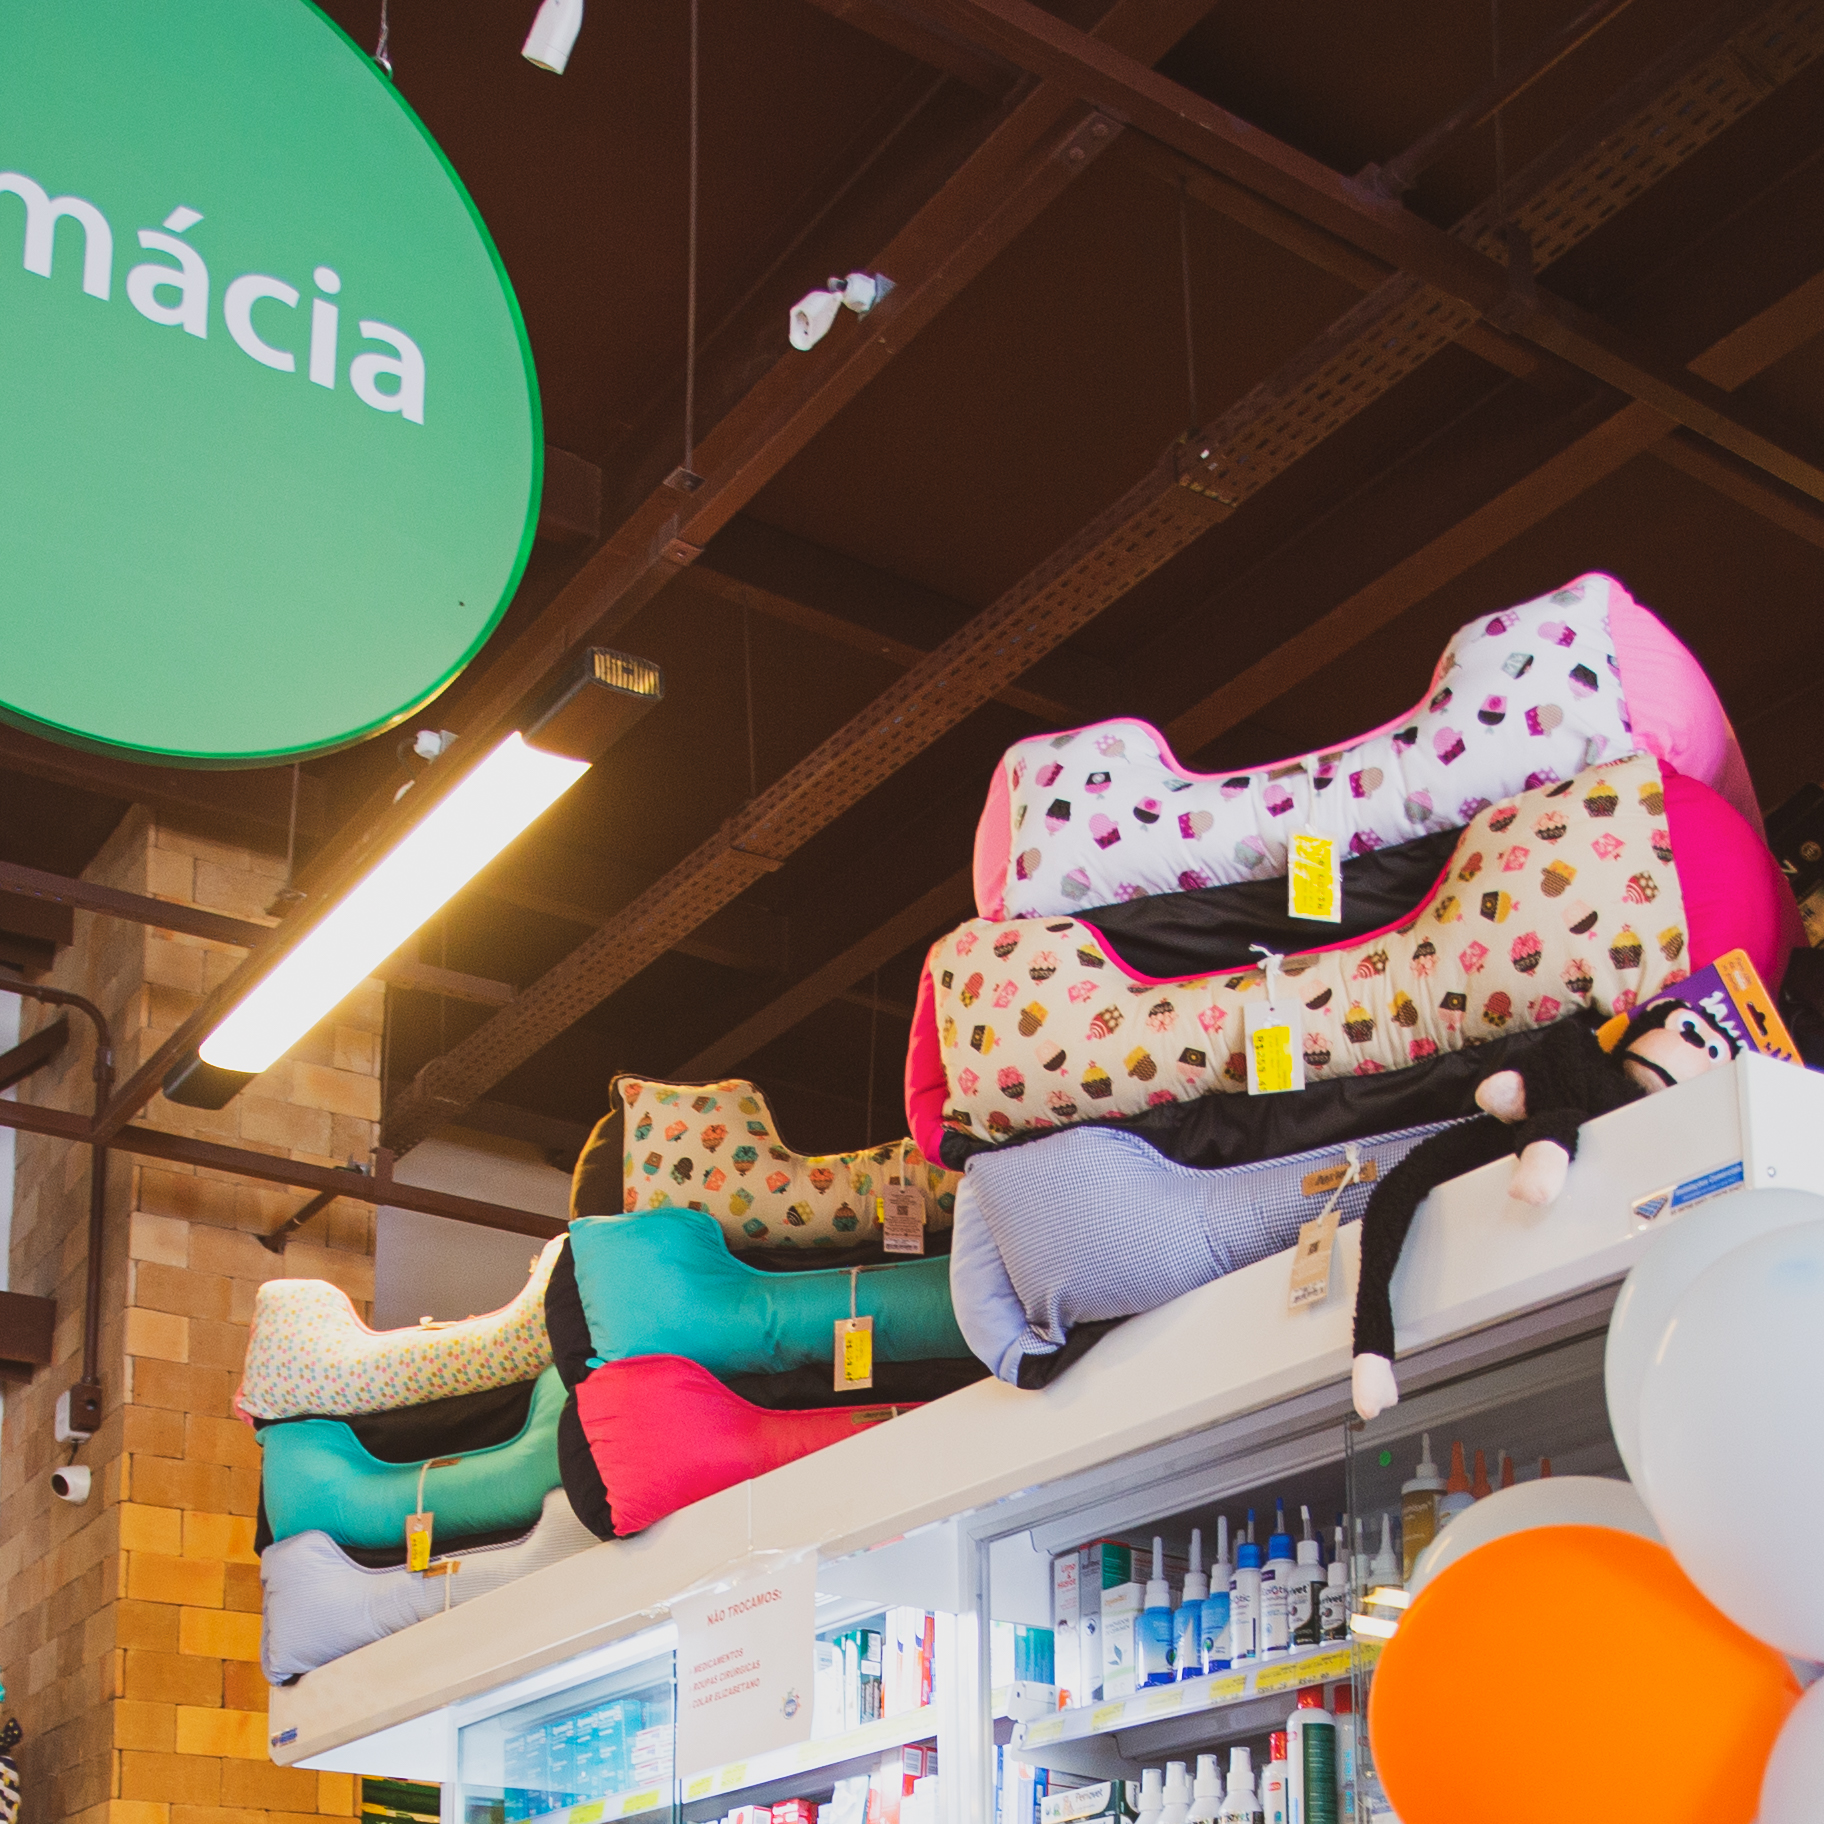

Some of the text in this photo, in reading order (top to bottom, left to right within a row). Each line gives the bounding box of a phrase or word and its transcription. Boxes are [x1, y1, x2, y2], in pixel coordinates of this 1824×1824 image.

[706, 1588, 782, 1627] NÃO TROCAMOS:
[693, 1648, 744, 1674] MEDICAMENTOS
